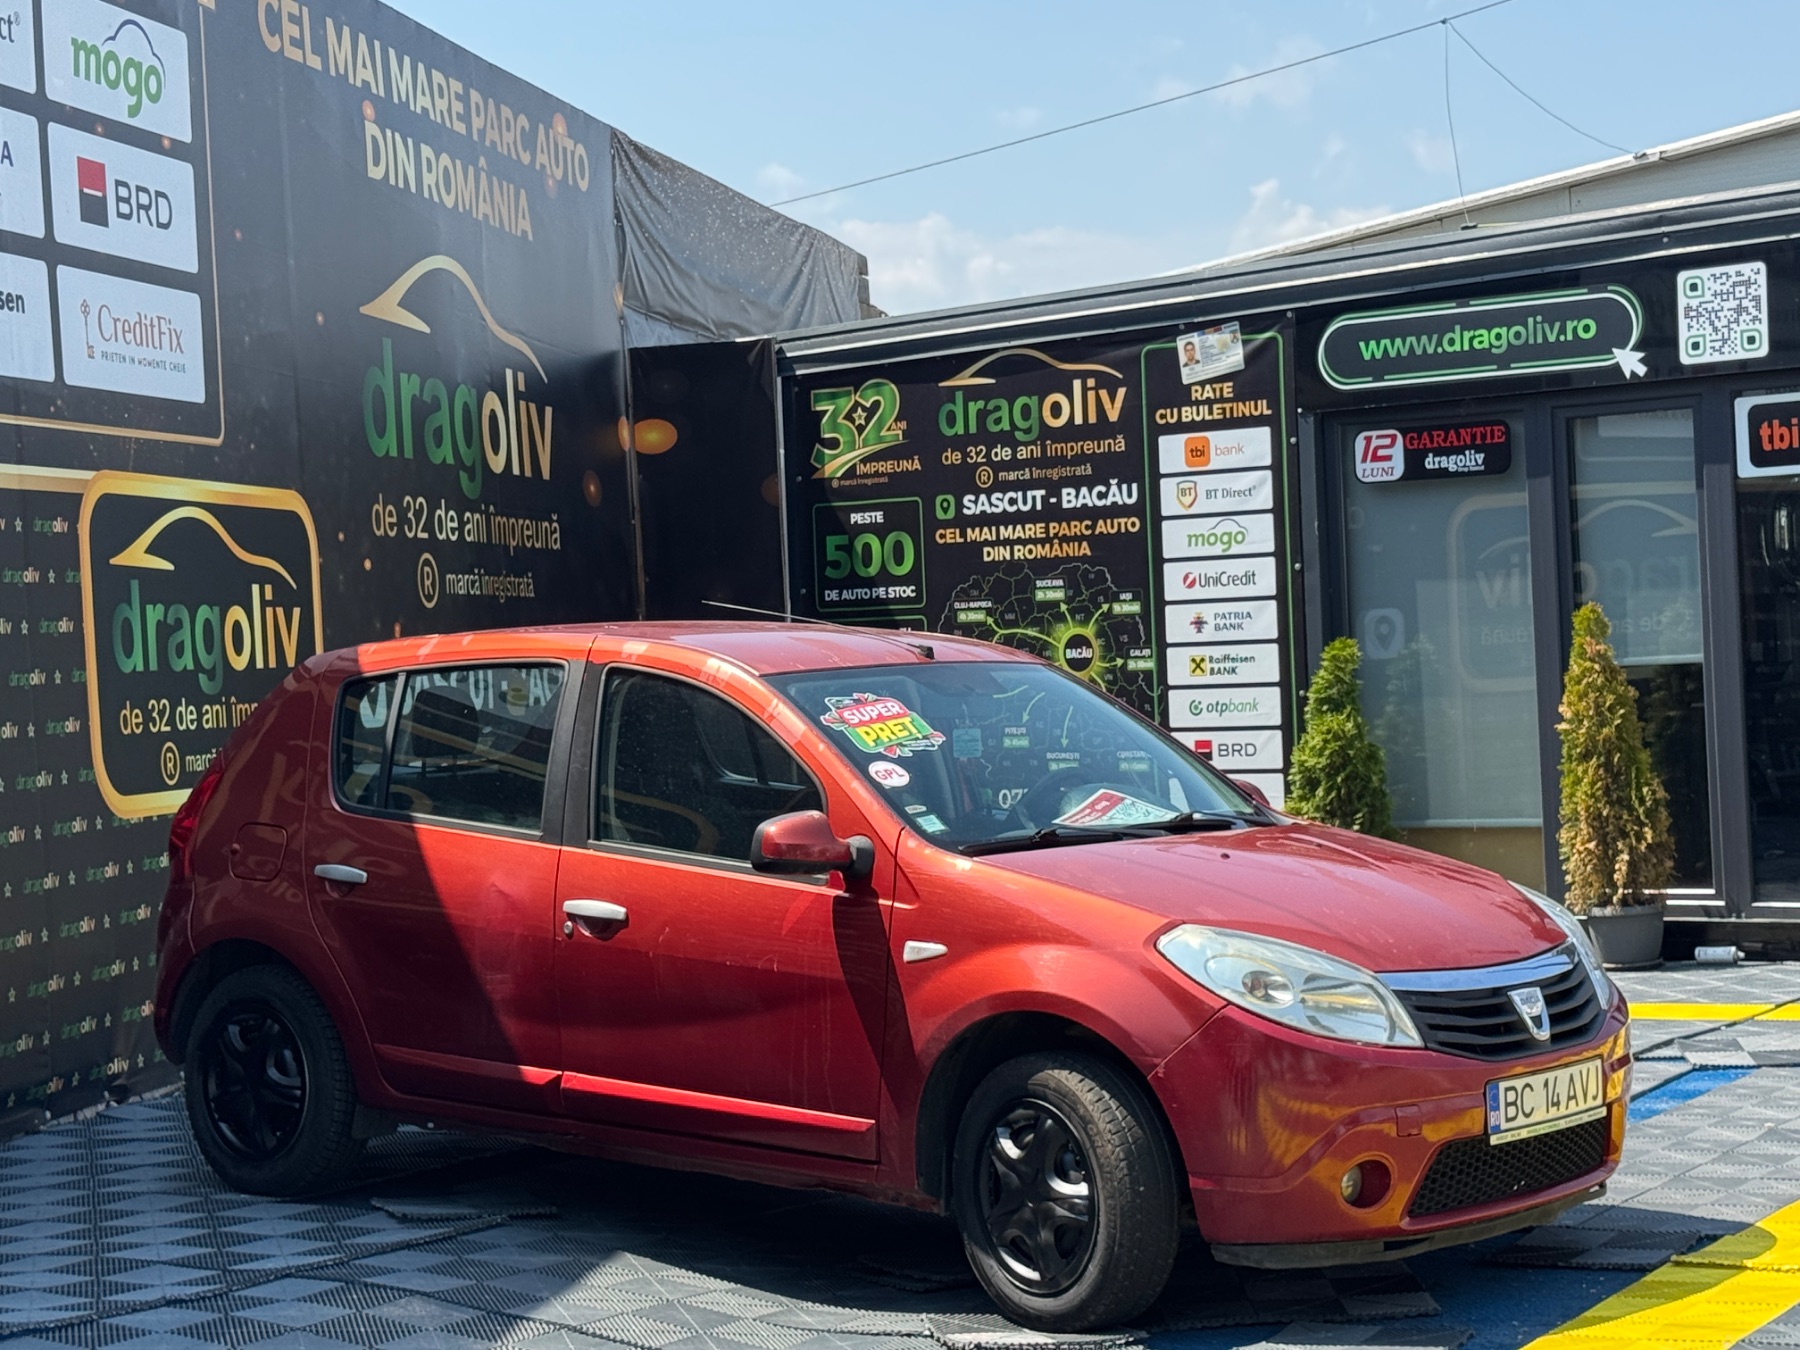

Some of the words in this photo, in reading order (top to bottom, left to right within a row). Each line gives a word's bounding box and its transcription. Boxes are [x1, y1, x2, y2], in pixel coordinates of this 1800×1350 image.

[71, 37, 163, 119] mogo
[257, 0, 322, 72] CEL
[325, 17, 385, 98] MAI
[388, 47, 467, 136] MARE
[470, 88, 531, 166] PARC
[535, 123, 590, 192] AUTO
[364, 120, 417, 194] DIN
[420, 142, 534, 241] ROMÂNIA
[114, 179, 174, 230] BRD
[98, 304, 185, 355] CreditFix
[1358, 315, 1598, 362] www.dragoliv.ro
[1190, 381, 1234, 401] RATE
[362, 336, 553, 500] dragoliv
[937, 377, 1128, 442] dragoliv
[1155, 408, 1179, 425] CU
[1180, 398, 1273, 423] BULETINUL
[809, 378, 903, 469] 32
[890, 420, 908, 431] ANI
[1759, 416, 1799, 452] tbi
[941, 447, 963, 466] de
[966, 445, 987, 464] 32
[990, 443, 1013, 462] de
[1016, 440, 1042, 459] ani
[1045, 433, 1126, 460] împreună
[1360, 433, 1398, 464] 12
[1405, 425, 1506, 450] GARANTIE
[1189, 445, 1206, 459] tbi
[1214, 442, 1245, 457] bank
[1425, 450, 1485, 472] dragoliv
[855, 455, 922, 477] ÎMPREUNĂ
[998, 466, 1031, 482] marcă
[1031, 462, 1093, 481] înregistrată
[1361, 466, 1396, 479] LUNI
[961, 489, 1047, 516] SASCUT
[1060, 477, 1139, 509] BACĂU
[1179, 486, 1194, 498] BT
[1205, 488, 1220, 500] BT
[33, 516, 69, 536] dragoliv
[372, 493, 398, 538] de
[403, 494, 429, 540] 32
[434, 498, 459, 542] de
[464, 502, 487, 544] ani
[489, 504, 562, 557] împreună
[850, 510, 885, 525] PESTE
[934, 527, 965, 545] CEL
[966, 524, 997, 543] MAI
[999, 522, 1047, 541] MARE
[1049, 519, 1093, 538] PARC
[1095, 516, 1141, 536] AUTO
[1186, 529, 1247, 554] mogo
[824, 530, 915, 580] 500
[982, 545, 1012, 563] DIN
[1013, 538, 1092, 561] ROMÂNIA
[2, 566, 40, 587] dragoliv
[446, 567, 481, 596] marcă
[481, 569, 536, 604] înregistrată
[1198, 569, 1257, 589] UniCredit
[824, 589, 840, 602] DE
[841, 587, 871, 601] AUTO
[872, 586, 887, 599] PE
[887, 585, 917, 598] STOC
[1214, 610, 1253, 622] PATRIA
[1214, 622, 1245, 632] BANK
[111, 578, 301, 695] dragoliv
[1065, 646, 1093, 659] BACĂU
[1208, 653, 1256, 664] Raiffeisen
[9, 668, 46, 689] dragoliv
[1209, 665, 1239, 676] BANK
[119, 700, 144, 735] de
[147, 698, 172, 733] 32
[175, 697, 198, 731] de
[201, 696, 228, 729] ani
[842, 701, 905, 725] SUPER
[1206, 697, 1260, 717] otpbank
[1217, 742, 1258, 758] BRD
[874, 767, 906, 781] GPL
[142, 851, 170, 873] dragoli
[1490, 1110, 1501, 1126] RO
[1503, 1082, 1535, 1124] BC
[1543, 1075, 1562, 1115] 14
[1565, 1064, 1601, 1111] AVJ
